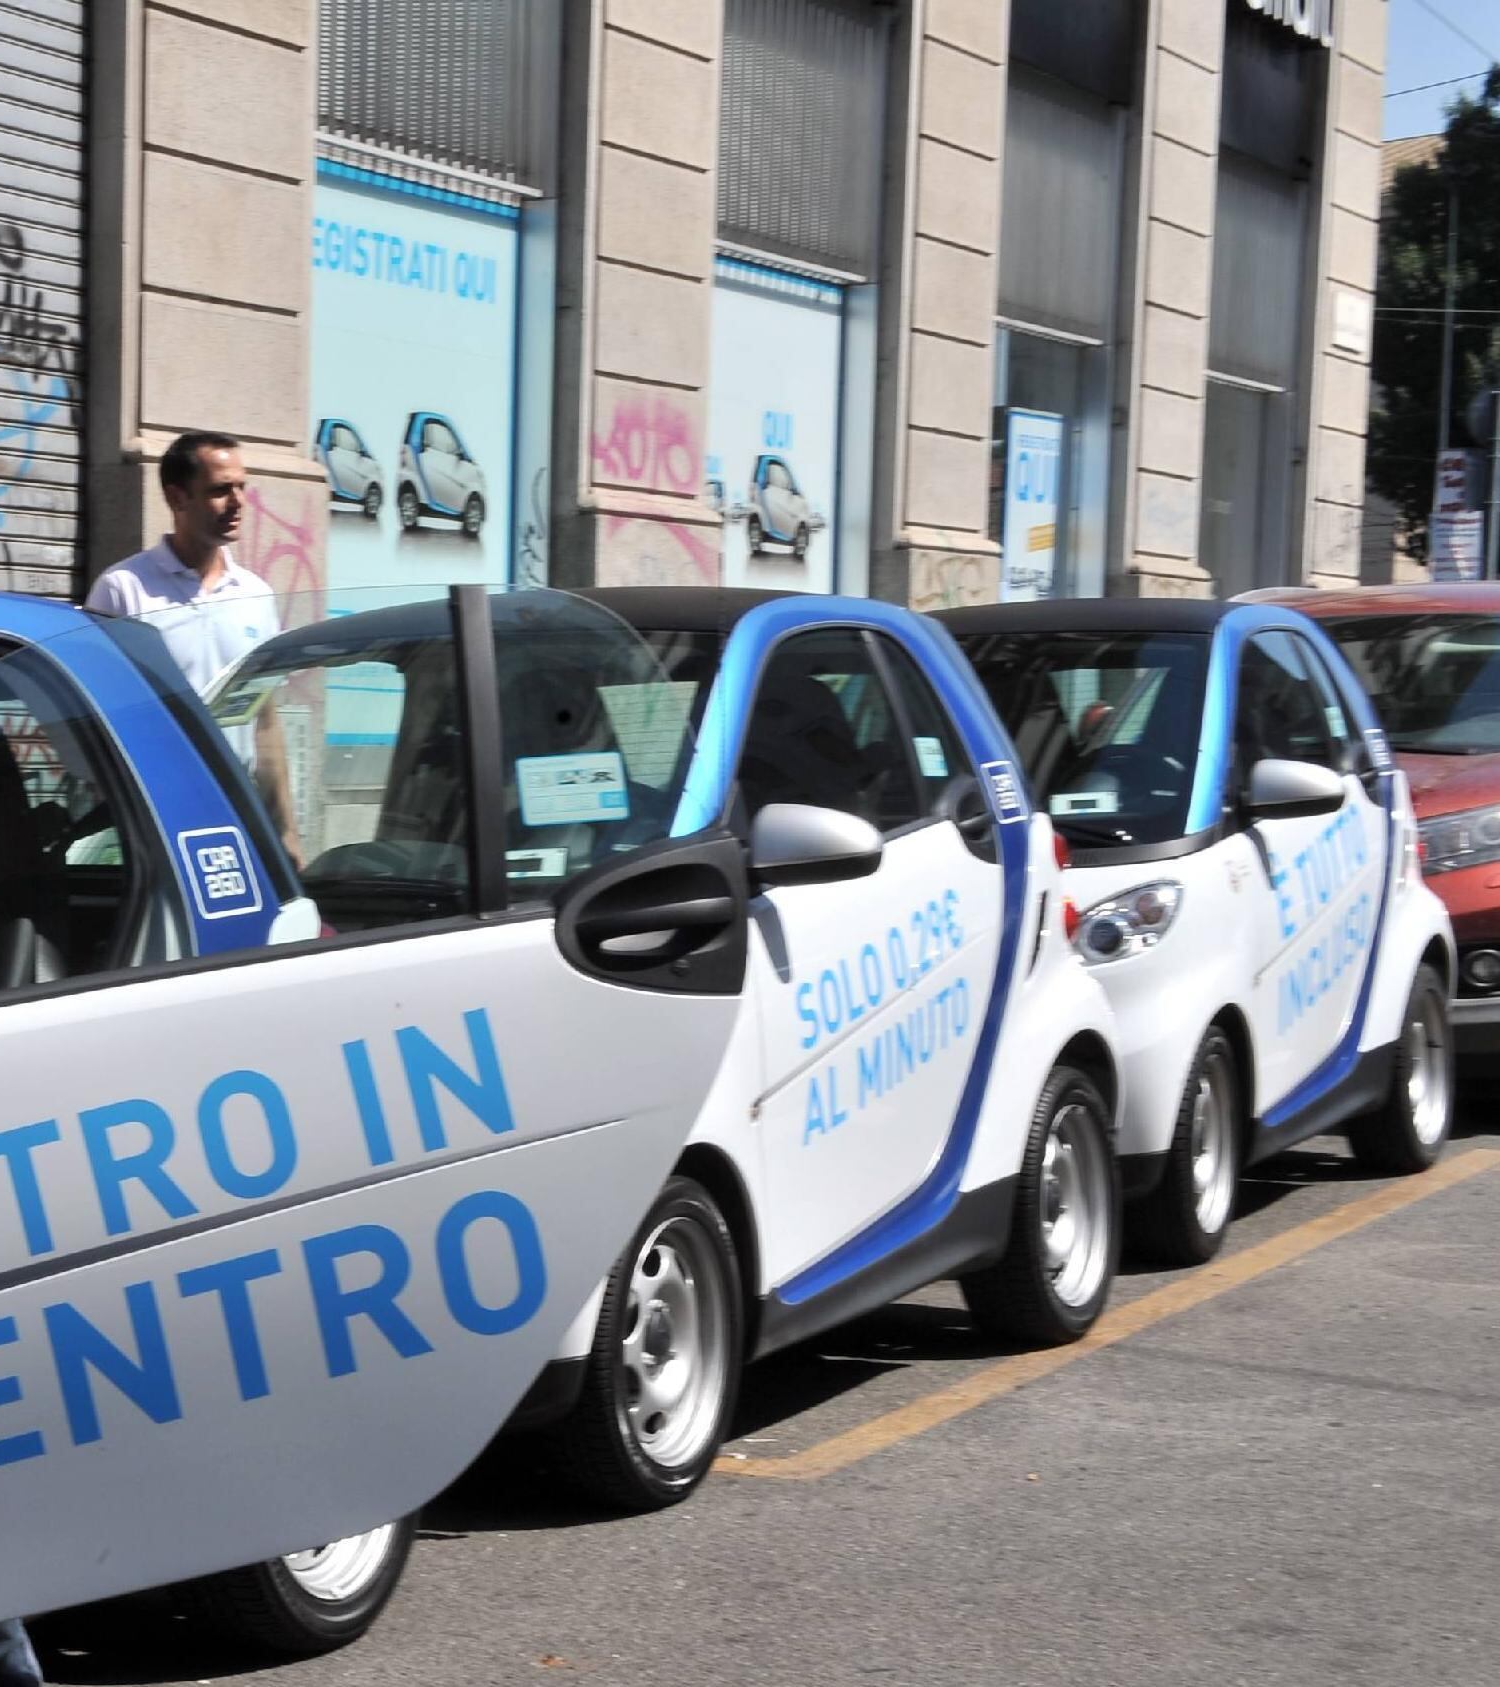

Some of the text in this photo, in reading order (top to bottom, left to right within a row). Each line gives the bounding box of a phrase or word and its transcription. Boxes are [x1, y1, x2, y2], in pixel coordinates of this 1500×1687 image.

[312, 217, 497, 305] EGISTRATI QUI
[795, 942, 884, 1050] SOLO
[802, 976, 970, 1147] AL MINUTO
[341, 1007, 516, 1168] IN
